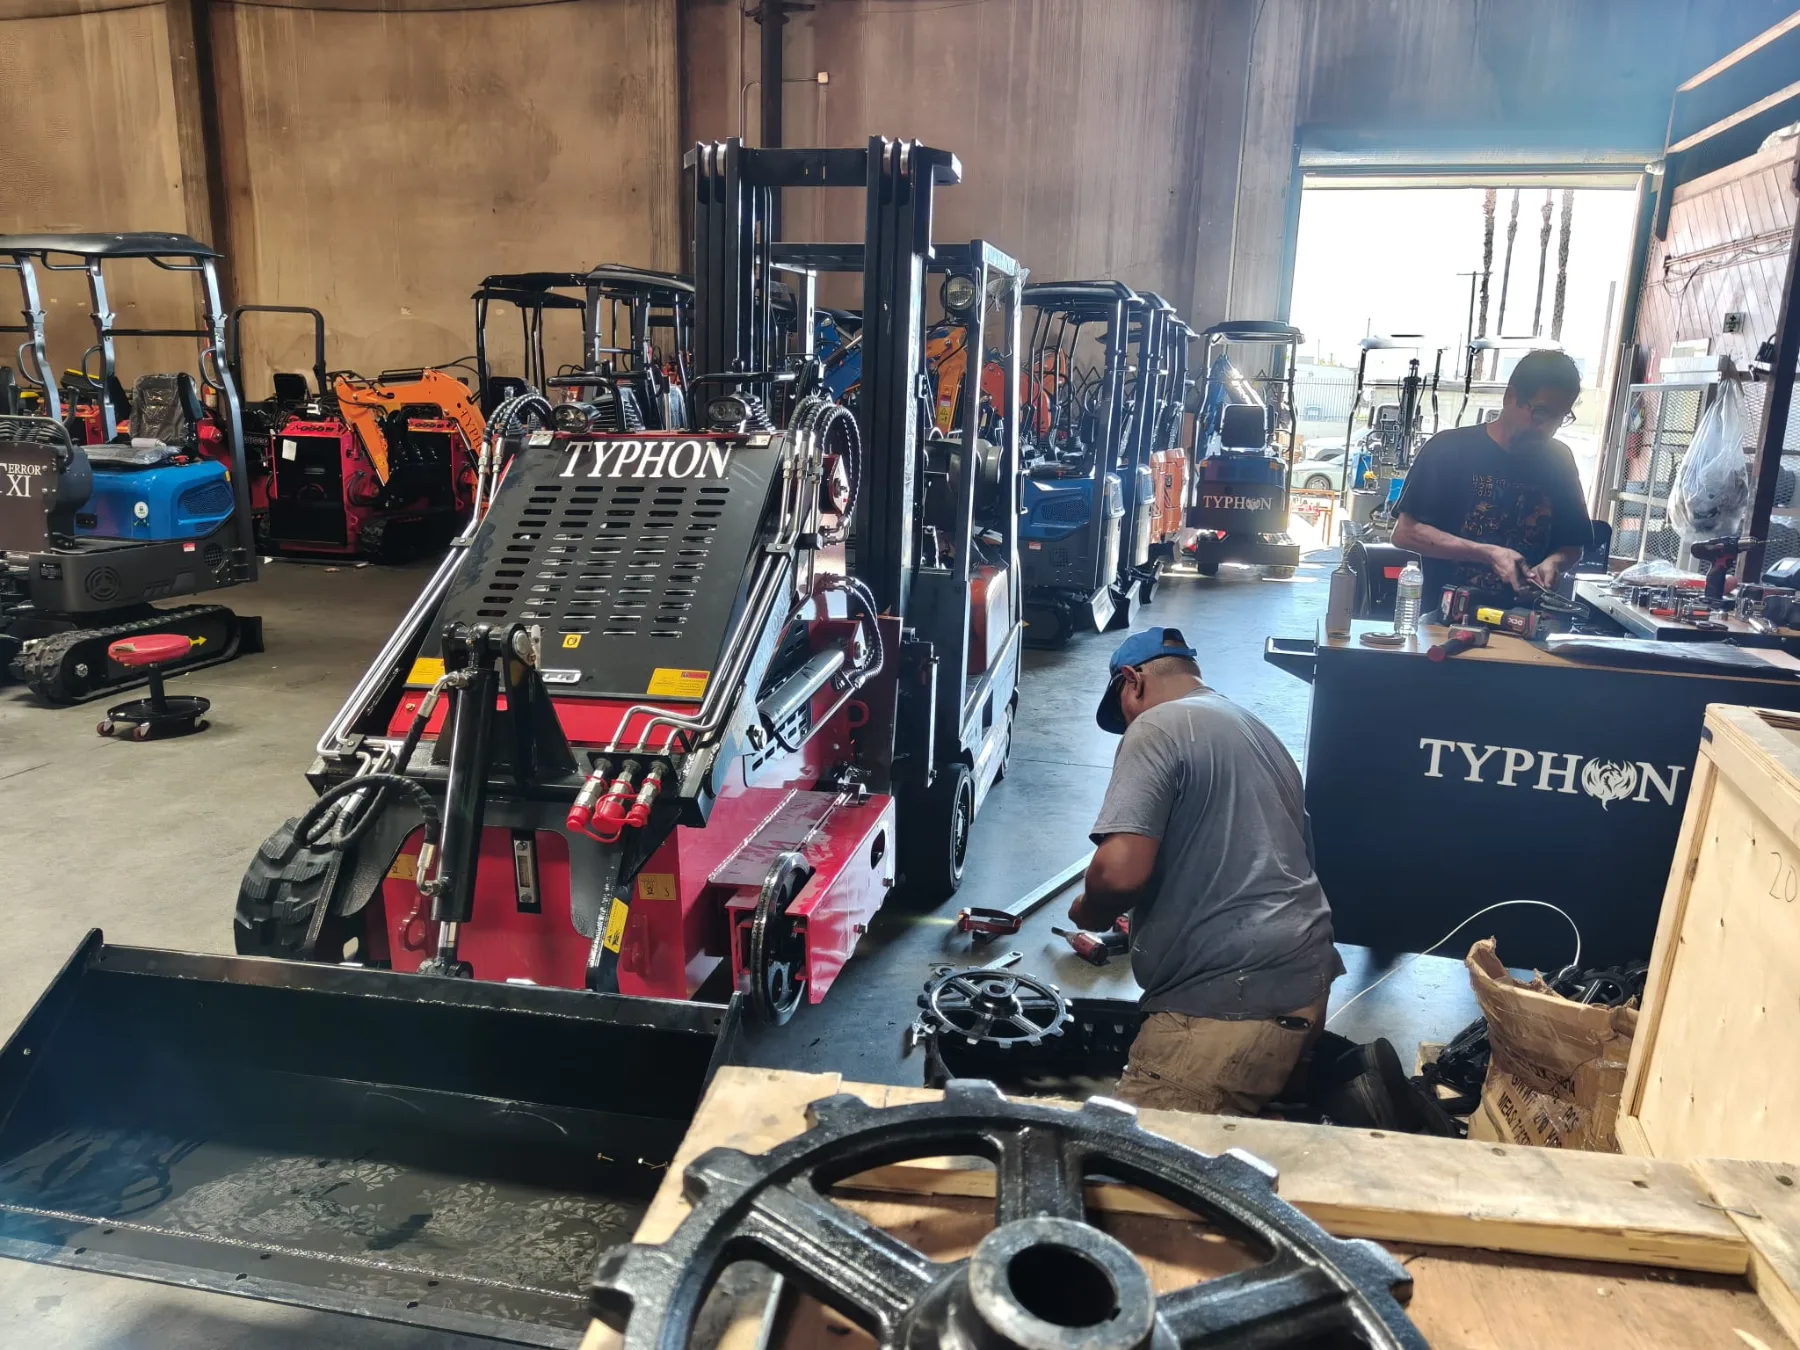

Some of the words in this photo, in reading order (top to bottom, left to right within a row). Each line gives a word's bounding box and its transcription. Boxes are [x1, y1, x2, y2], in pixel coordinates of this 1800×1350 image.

[461, 408, 482, 448] TYPH
[559, 440, 737, 479] TYPHON
[6, 474, 32, 498] XI
[1203, 495, 1273, 511] TYPHON
[1419, 737, 1686, 811] TYPHON
